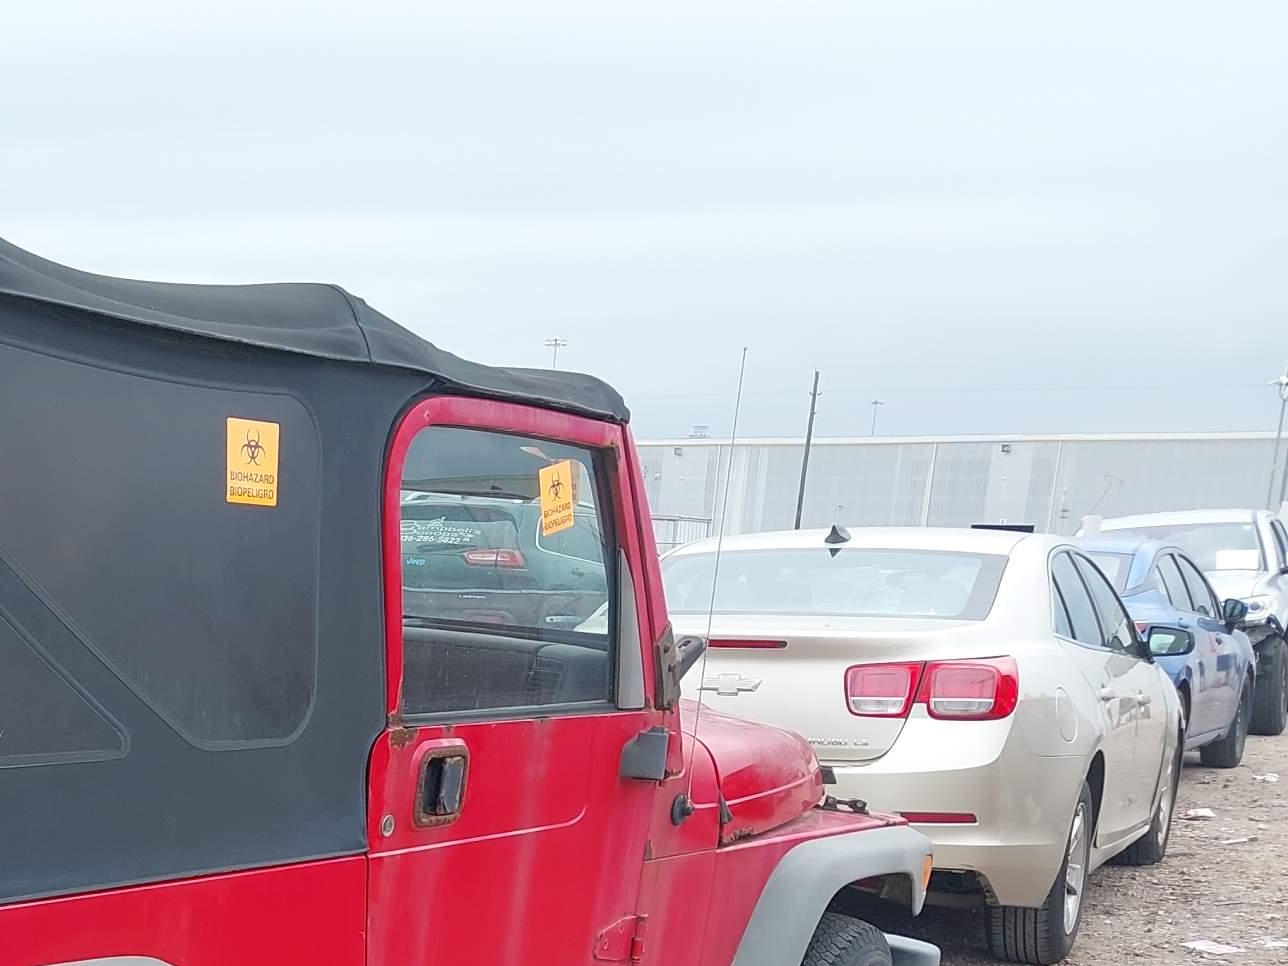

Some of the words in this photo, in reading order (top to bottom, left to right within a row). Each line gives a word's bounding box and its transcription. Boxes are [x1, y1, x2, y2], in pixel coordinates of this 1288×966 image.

[230, 470, 274, 485] BIOHAZARD
[229, 486, 274, 500] BIOPELIGRO
[543, 501, 572, 519] BIOHAZARD
[406, 556, 426, 567] Jeep
